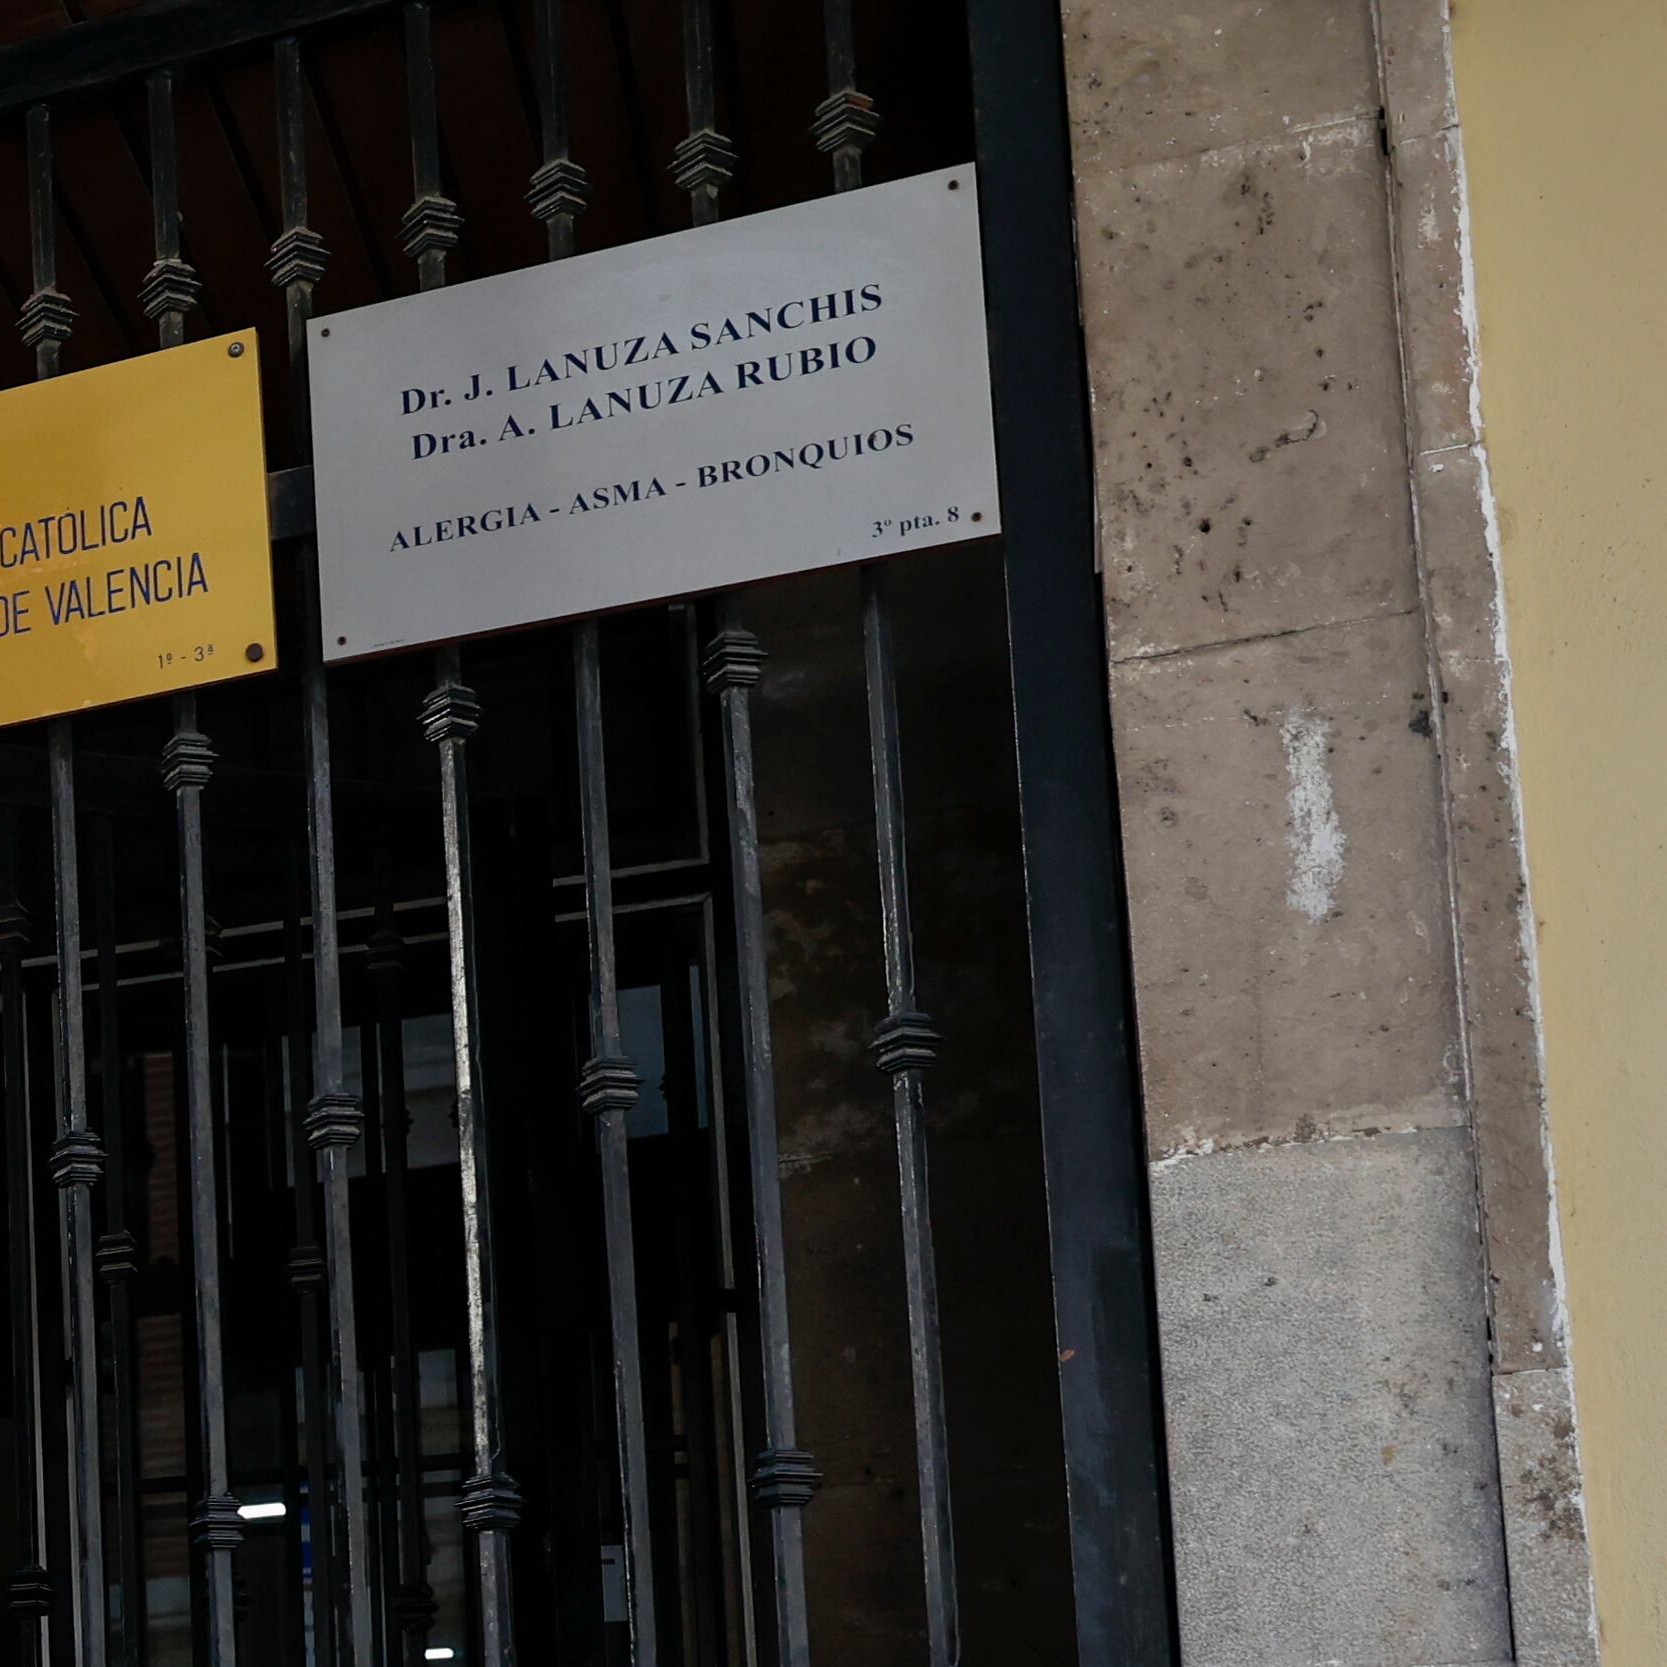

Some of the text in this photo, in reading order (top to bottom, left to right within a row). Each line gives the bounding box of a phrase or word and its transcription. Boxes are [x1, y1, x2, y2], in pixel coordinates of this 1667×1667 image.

[400, 283, 882, 416] Dr. J. LANUZA SANCHIS
[411, 336, 877, 461] Dra. A. LANUZA RUBIO
[0, 496, 152, 568] CATÓLICA
[389, 502, 541, 553] ALERGIA
[569, 477, 667, 516] ASMA
[697, 424, 915, 489] BRONQUIOS
[898, 514, 941, 538] pta.
[947, 506, 959, 523] 8
[45, 553, 208, 625] VALENCIA
